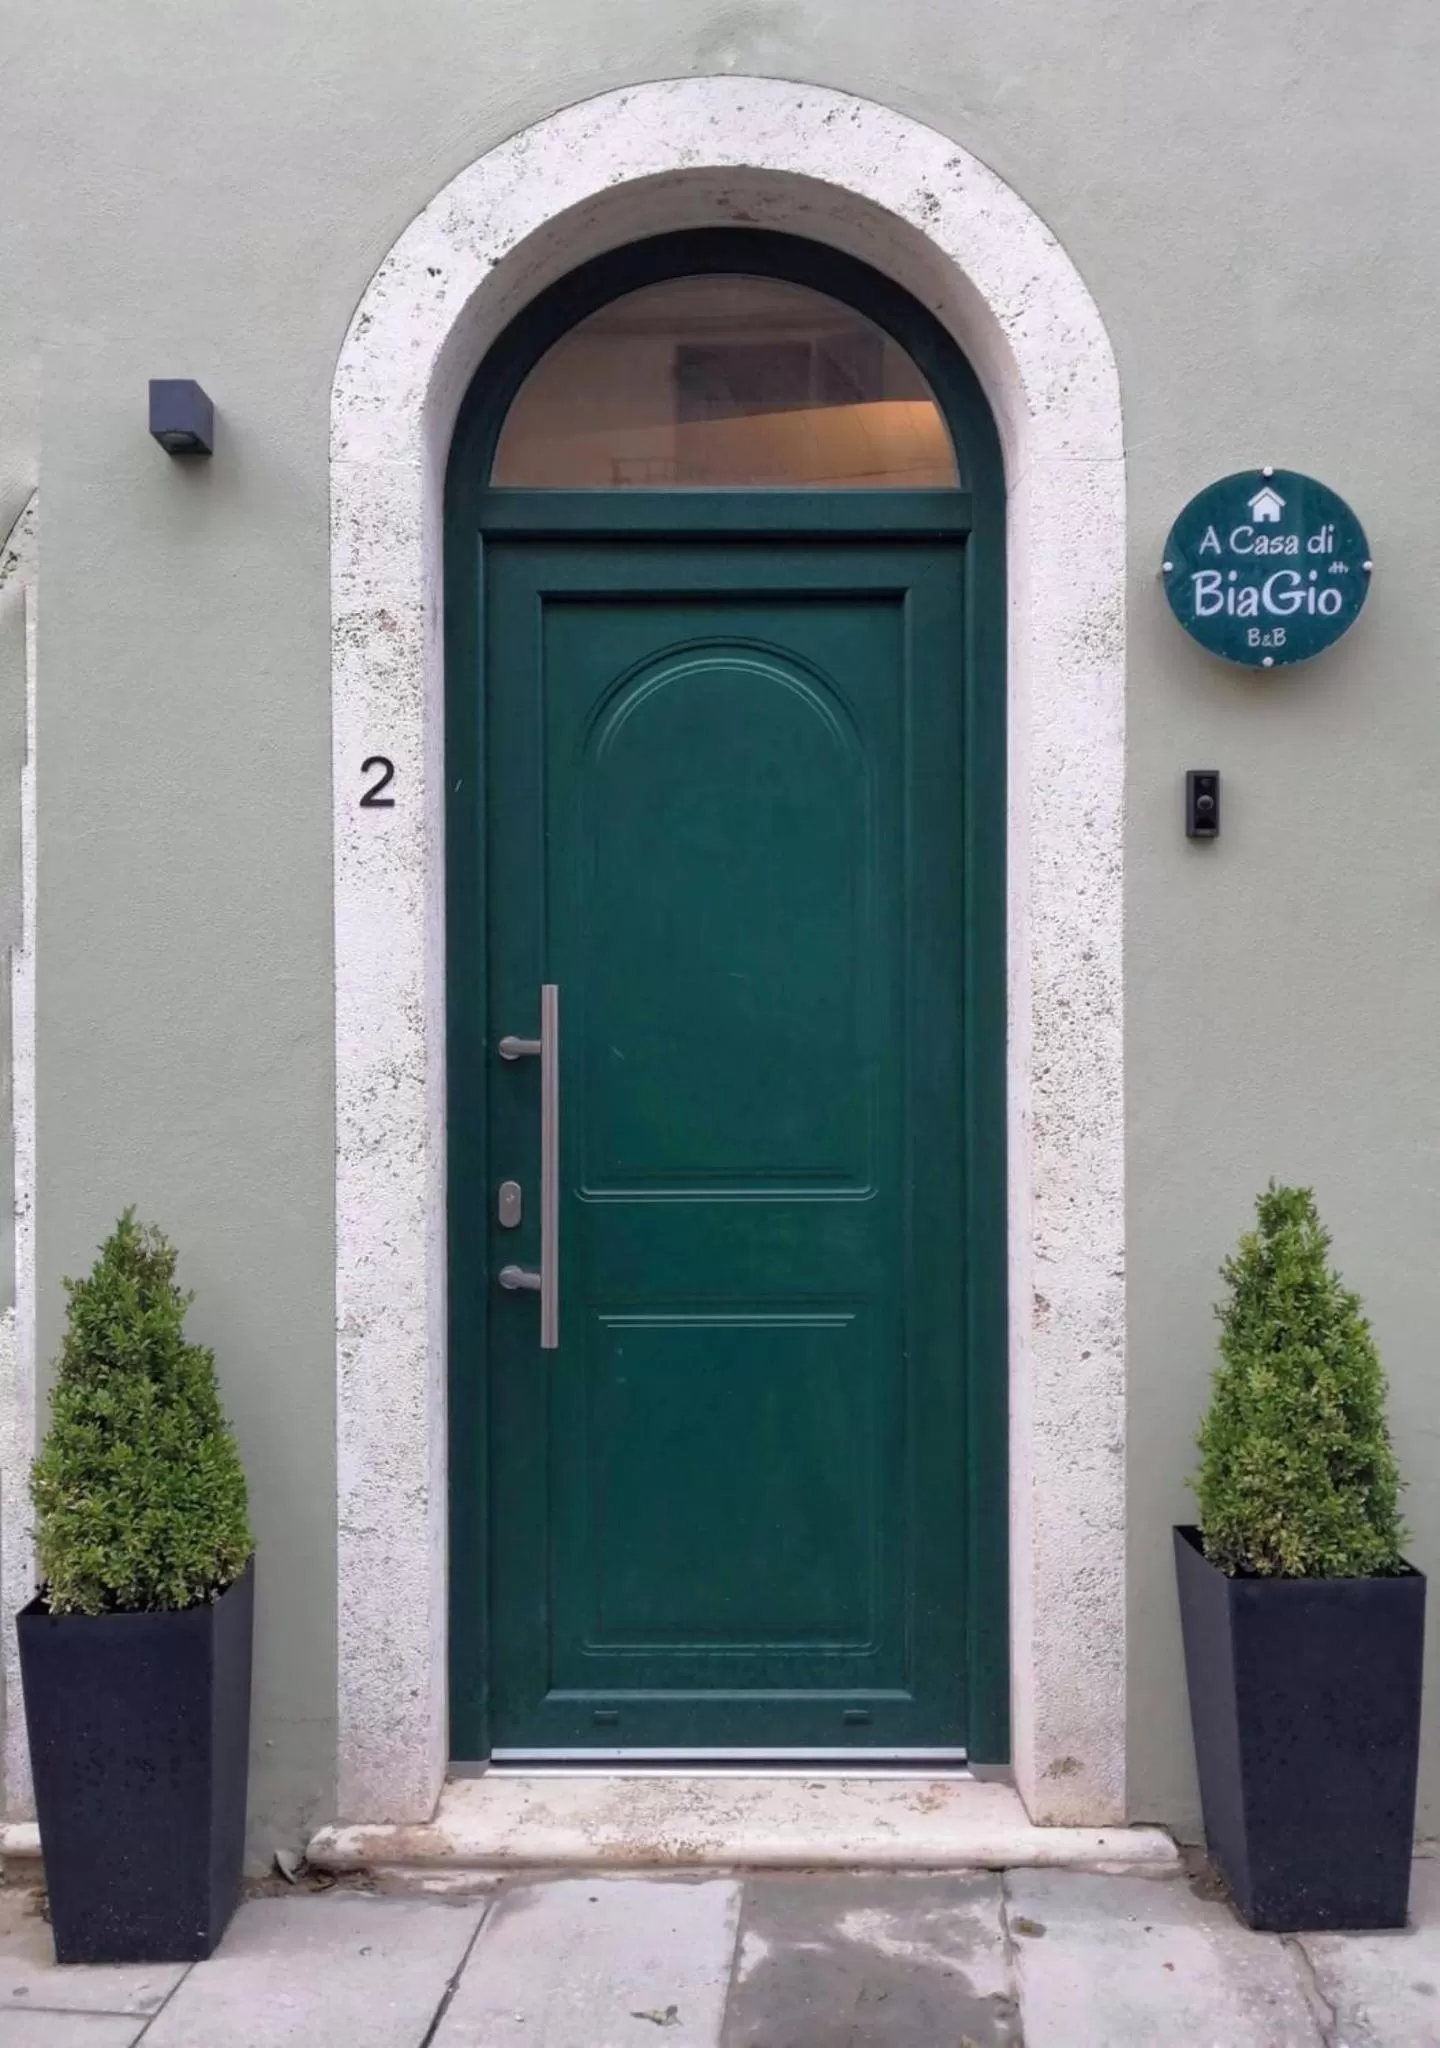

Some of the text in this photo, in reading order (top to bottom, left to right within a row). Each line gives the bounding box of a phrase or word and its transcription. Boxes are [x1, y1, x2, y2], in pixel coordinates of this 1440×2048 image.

[1199, 524, 1335, 555] A Casa di
[1191, 570, 1343, 617] BiaGio
[1247, 628, 1287, 647] B&B
[360, 755, 395, 808] 2
